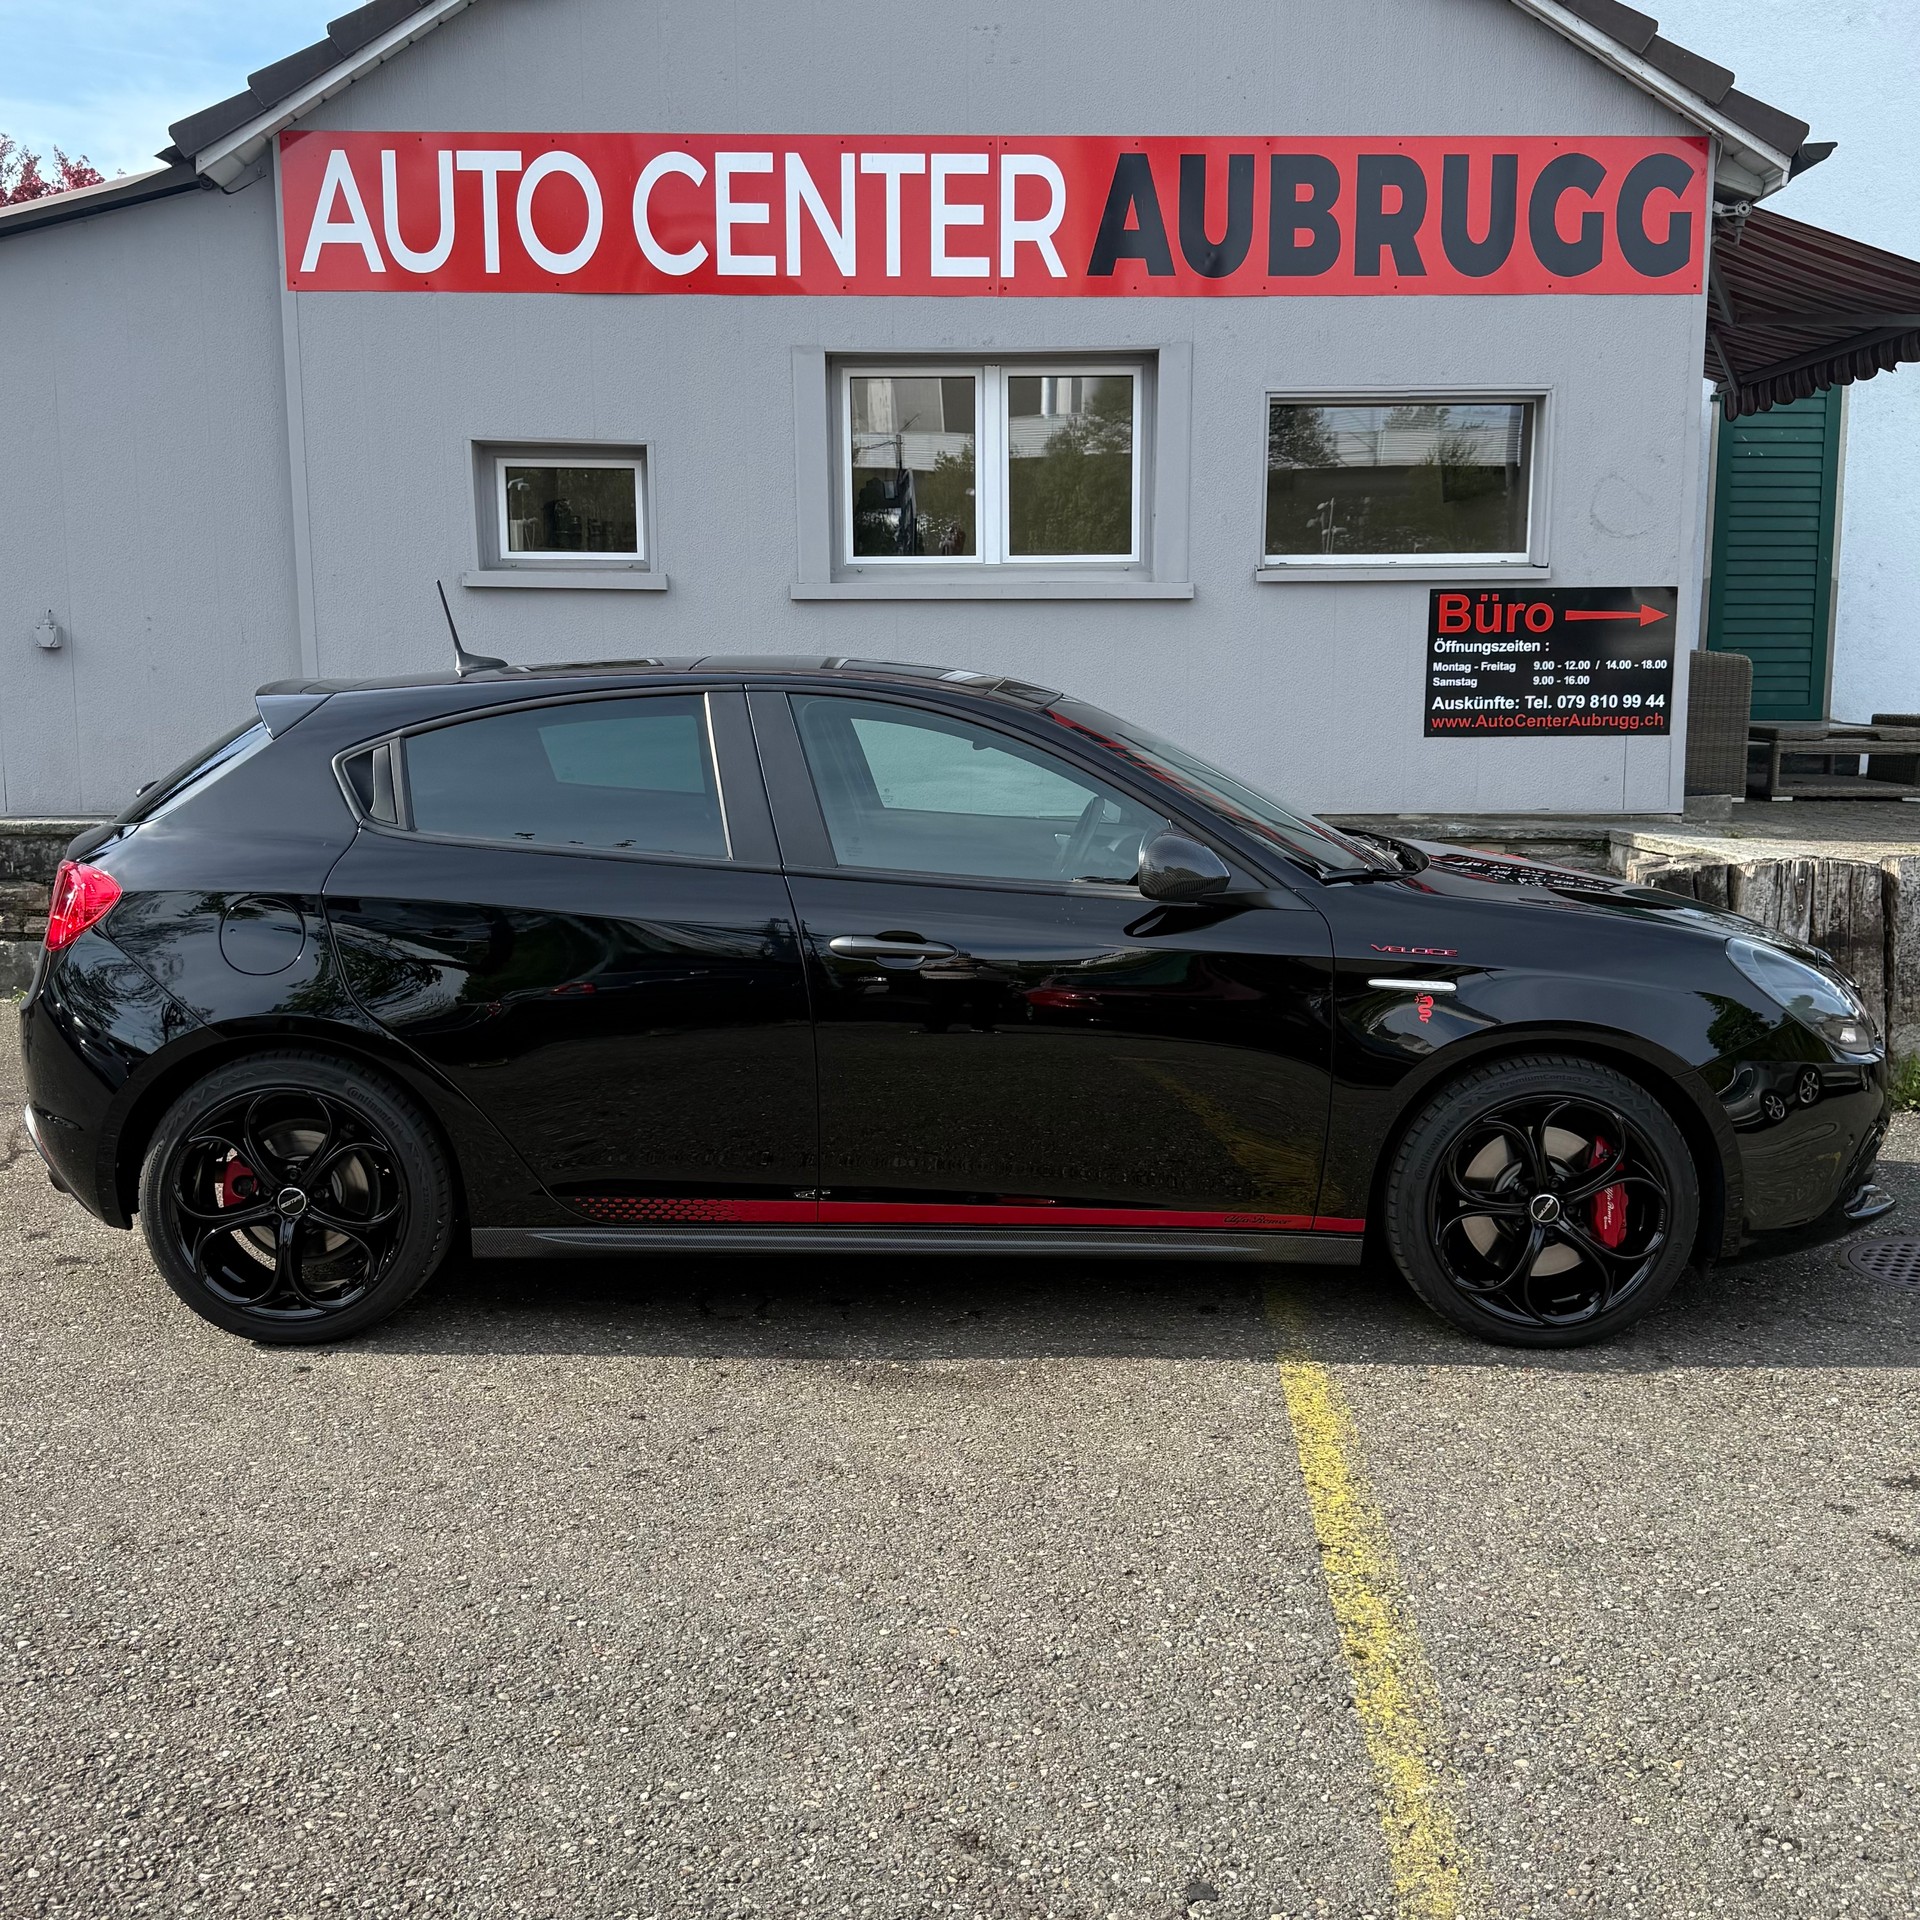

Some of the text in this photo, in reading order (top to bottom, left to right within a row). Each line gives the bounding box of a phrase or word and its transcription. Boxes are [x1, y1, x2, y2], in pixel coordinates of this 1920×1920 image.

[299, 150, 1696, 278] AUTO CENTER AUBRUGG
[1437, 593, 1555, 634] Büro
[1433, 638, 1541, 655] Öffnungszeiten
[1432, 661, 1472, 674] Montag
[1480, 661, 1517, 673] Freitag
[1533, 660, 1555, 671] 9.00
[1564, 660, 1591, 670] 12.00
[1605, 659, 1632, 670] 14.00
[1641, 659, 1668, 670] 18.00
[1432, 676, 1478, 689] Samstag
[1532, 675, 1555, 685] 9.00
[1563, 675, 1591, 685] 16.00
[1431, 693, 1666, 711] Auskünfte: Tel. 079 810 99 44
[1431, 712, 1664, 730] www.AutoCenterAubrugg.ch
[1370, 944, 1458, 957] VELOCE
